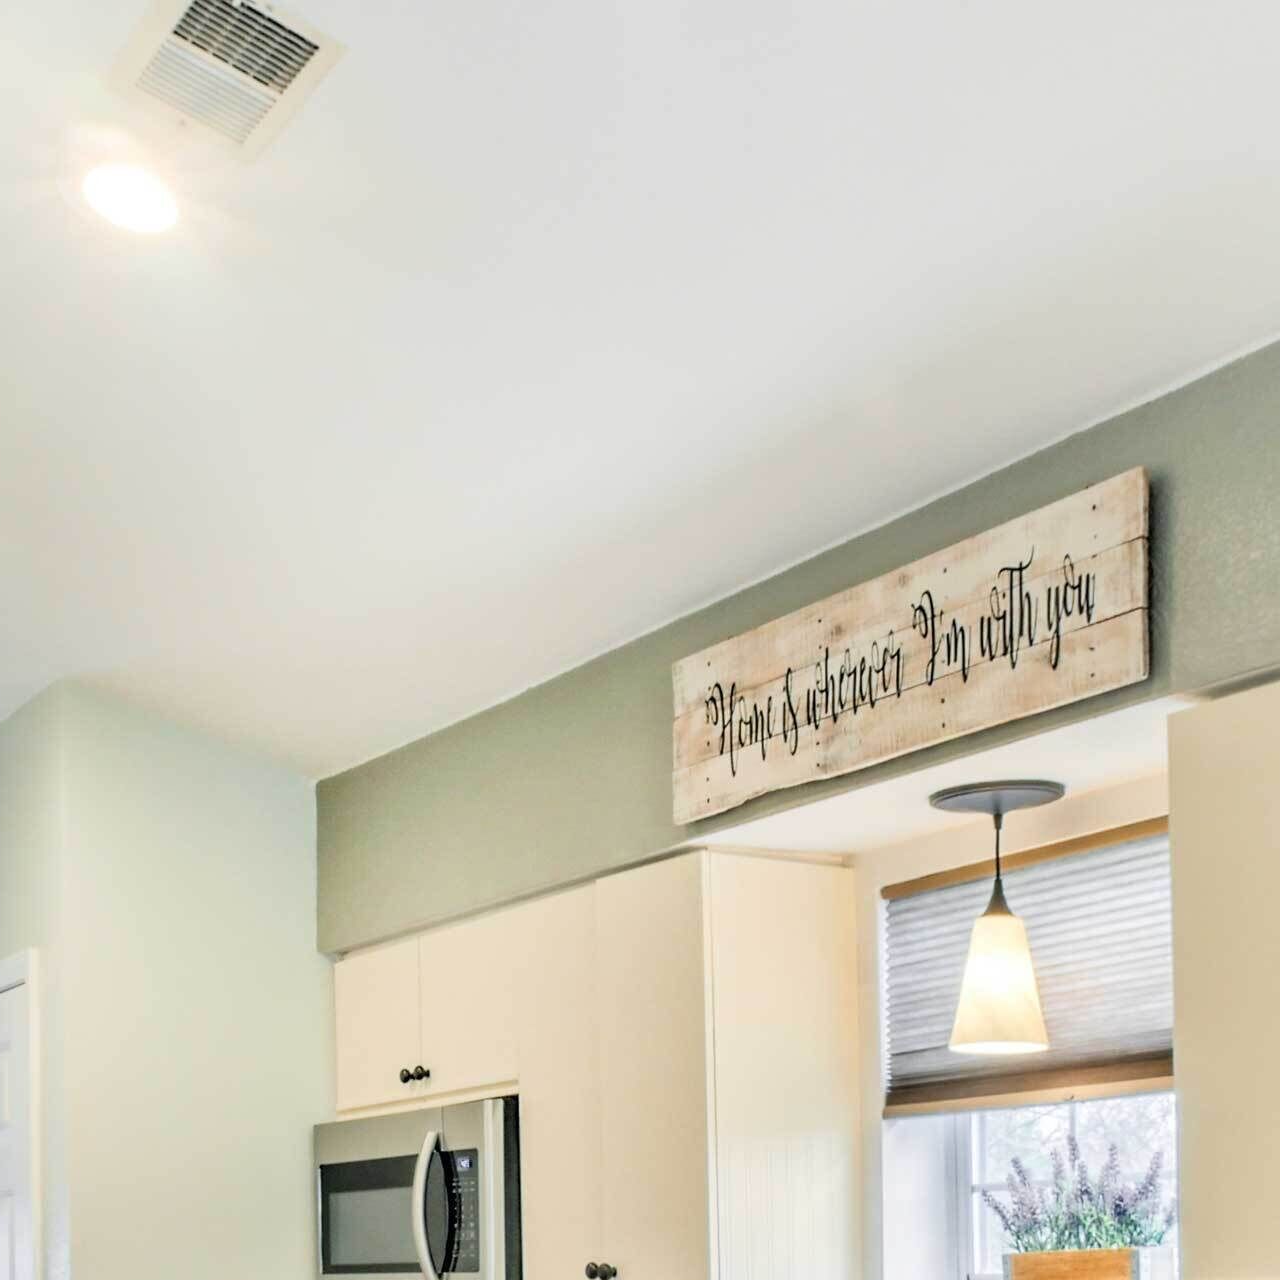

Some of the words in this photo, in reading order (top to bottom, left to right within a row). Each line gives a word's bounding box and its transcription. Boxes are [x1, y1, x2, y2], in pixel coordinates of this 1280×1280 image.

[705, 682, 778, 777] Home
[782, 667, 802, 756] is
[806, 630, 904, 731] wherever
[911, 590, 971, 686] I'm
[980, 544, 1039, 669] with
[1047, 553, 1095, 670] you
